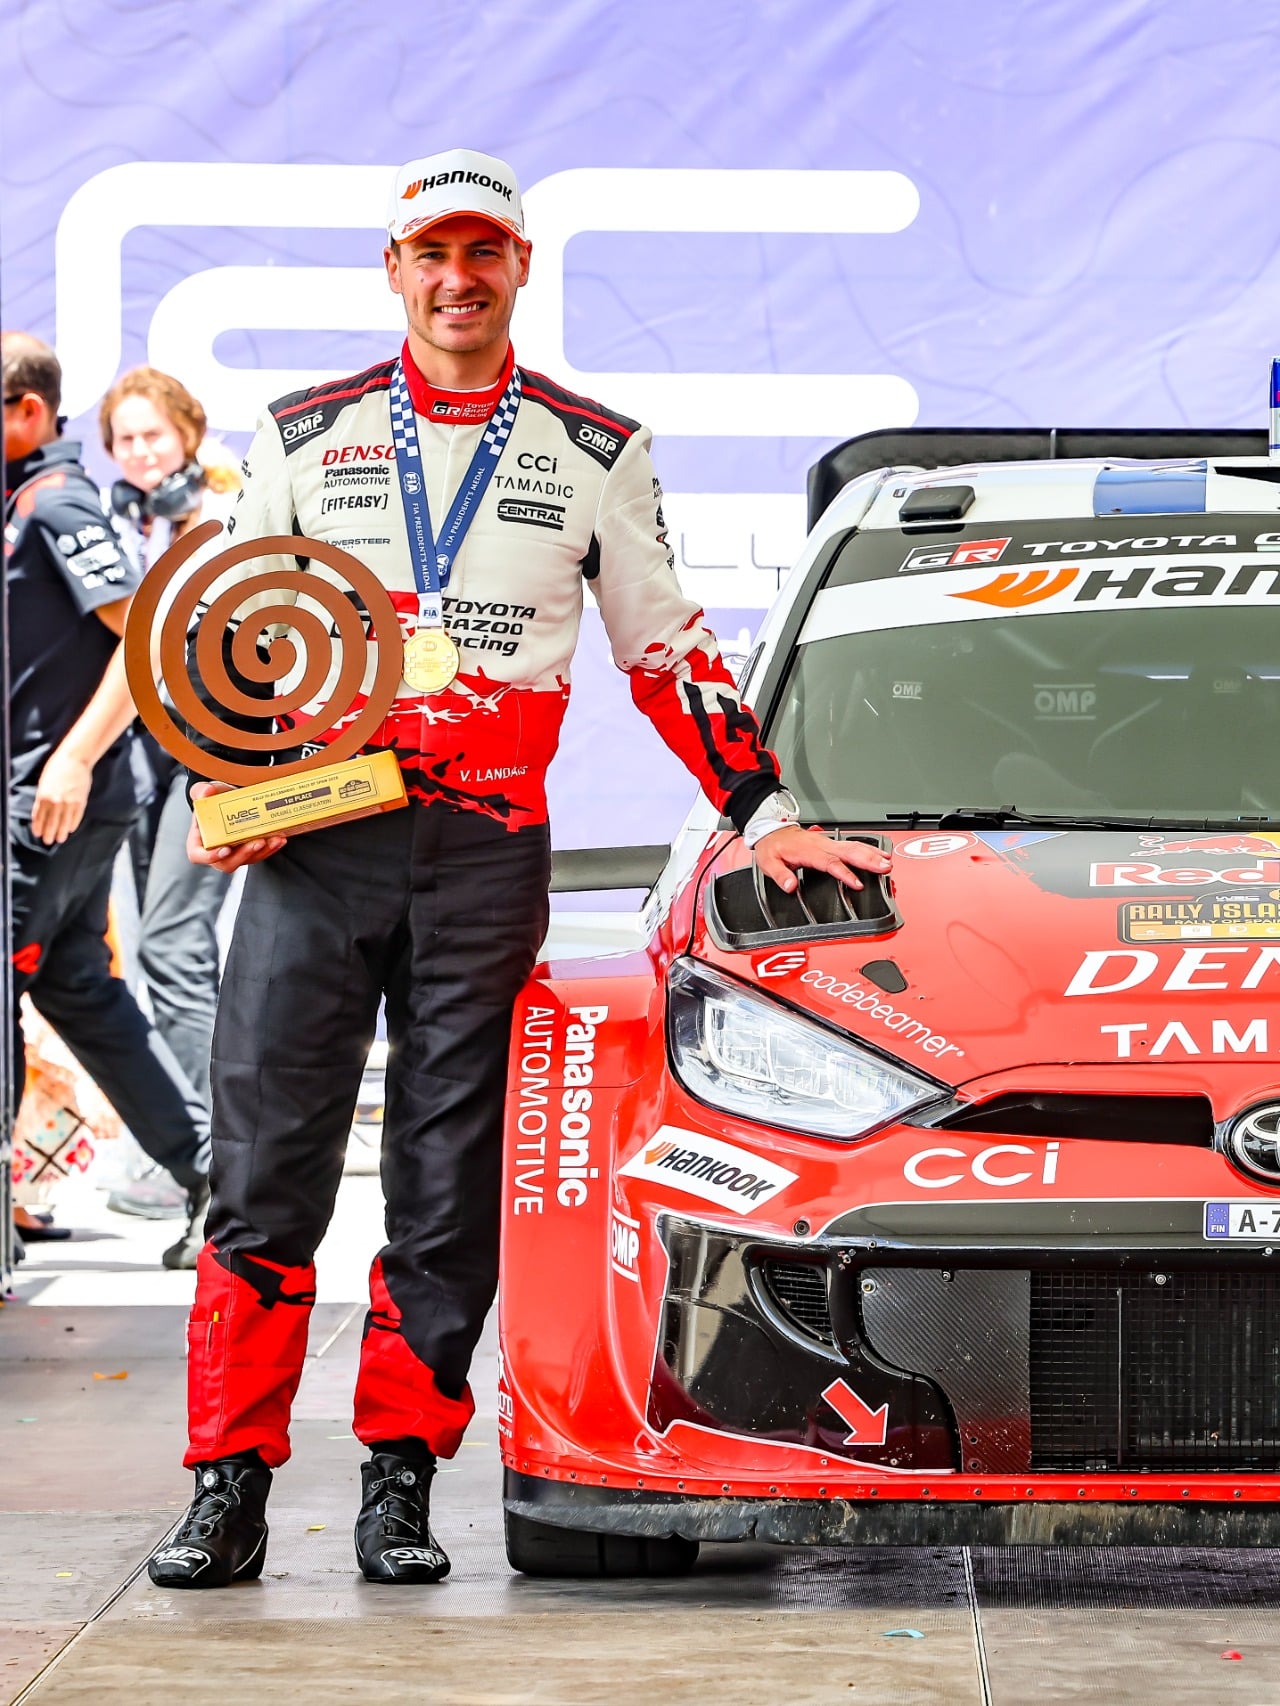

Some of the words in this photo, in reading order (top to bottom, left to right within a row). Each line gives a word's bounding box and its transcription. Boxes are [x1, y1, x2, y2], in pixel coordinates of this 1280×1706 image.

[432, 405, 460, 416] GR
[283, 414, 323, 440] OMP
[578, 428, 617, 453] OMP
[322, 445, 397, 465] DENSO
[325, 465, 389, 478] Panasonic
[471, 467, 485, 491] MEDAL
[324, 477, 390, 489] AUTOMOTIVE
[494, 475, 574, 499] TAMADIC
[497, 503, 564, 524] CENTRAL
[906, 547, 1000, 569] GR
[1023, 535, 1237, 556] TOYOTA
[422, 564, 431, 591] MEDAL
[424, 608, 438, 618] FIA
[442, 597, 536, 619] TOYOTA
[450, 634, 519, 656] acing
[893, 684, 922, 697] OMP
[1034, 690, 1097, 713] OMP
[459, 769, 472, 782] V.
[226, 807, 259, 822] WRC
[1130, 903, 1202, 919] RALLY
[799, 968, 961, 1059] codebeamer
[513, 1006, 555, 1216] AUTOMOTIVE
[556, 1005, 609, 1208] Panasonic
[1211, 1224, 1226, 1233] FIN
[612, 1224, 639, 1269] OMP
